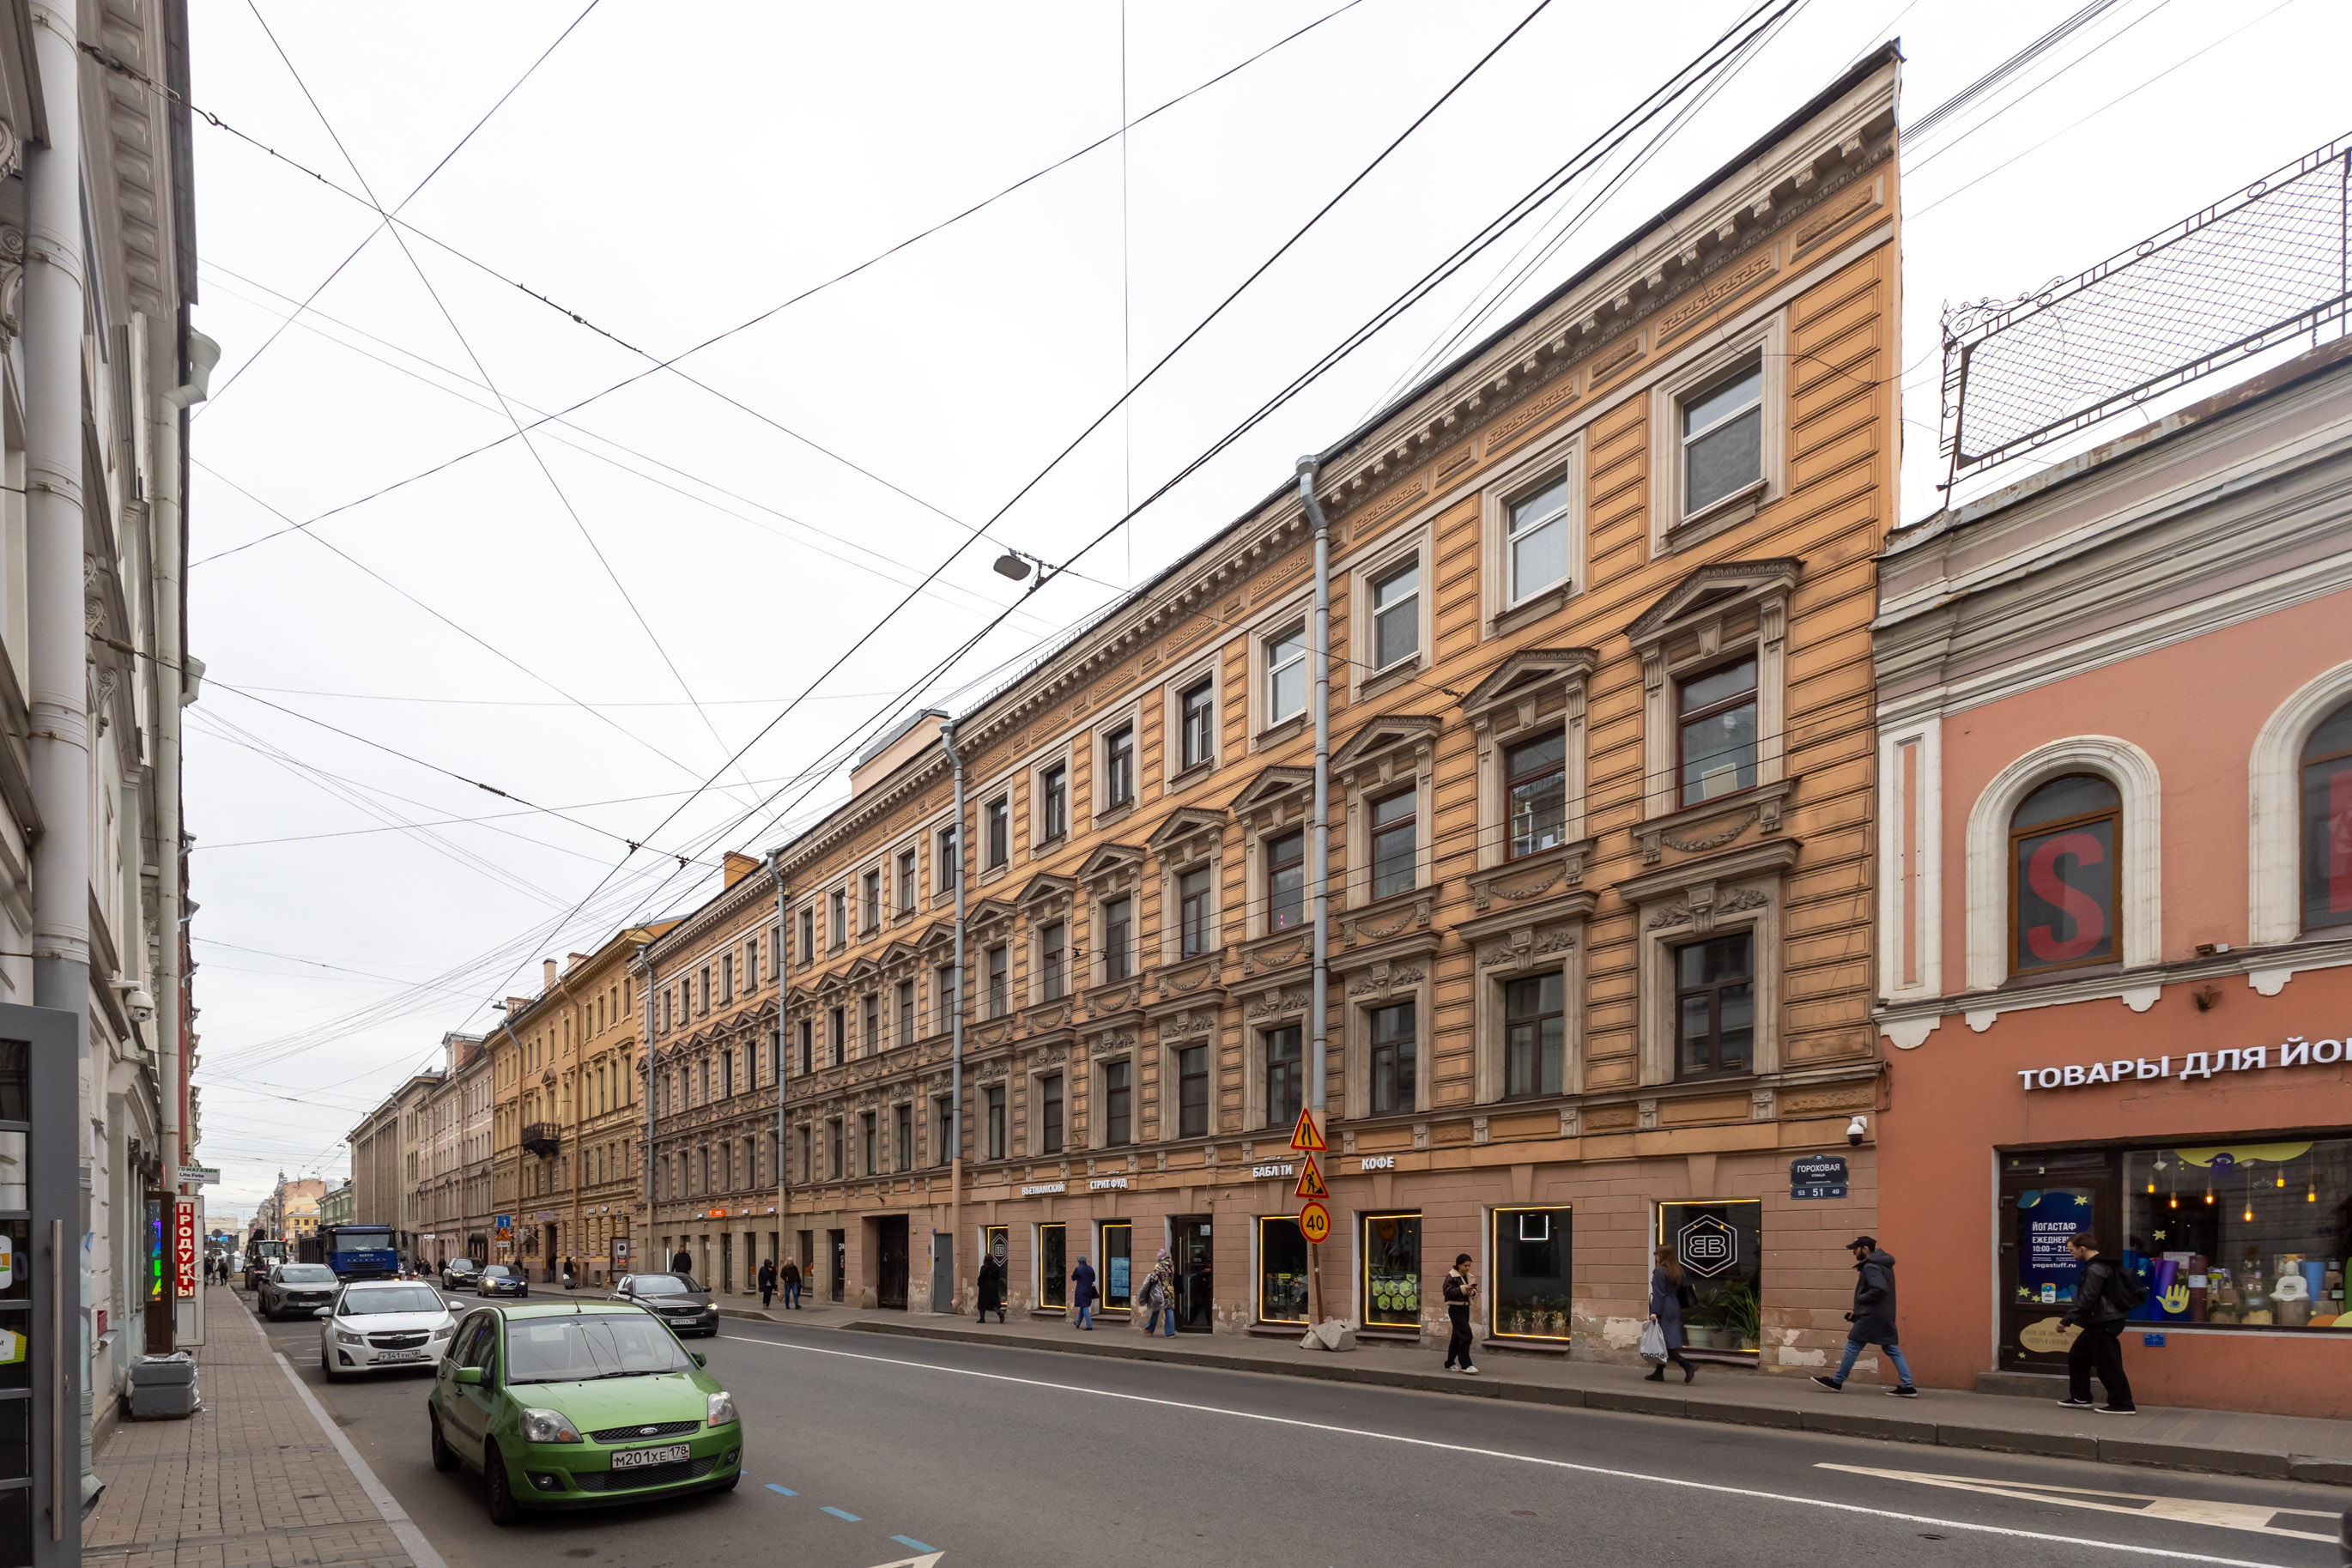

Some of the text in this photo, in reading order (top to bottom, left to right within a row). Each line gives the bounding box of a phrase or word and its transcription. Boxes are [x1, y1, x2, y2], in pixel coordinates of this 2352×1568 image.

[2027, 832, 2105, 961] S
[2017, 1055, 2170, 1090] ТОВАРЫ
[2179, 1045, 2267, 1081] ДЛЯ
[1361, 1156, 1395, 1170] КОФЕ
[1797, 1163, 1840, 1173] ГОРОХОВАЯ
[1252, 1164, 1294, 1178] БАБЛ ТИ
[1021, 1182, 1065, 1196] ВЬЕТНАМСКИЙ
[1089, 1178, 1128, 1190] СТРИТ ФУД
[1812, 1188, 1824, 1196] 51
[1306, 1214, 1325, 1231] 40
[2032, 1221, 2076, 1232] ЙОГАСТАФ
[2032, 1236, 2070, 1244] ЕЖЕДНЕВ
[178, 1202, 194, 1297] ПРОДУКТЫ
[615, 1445, 687, 1466] М201ХЕ 178
